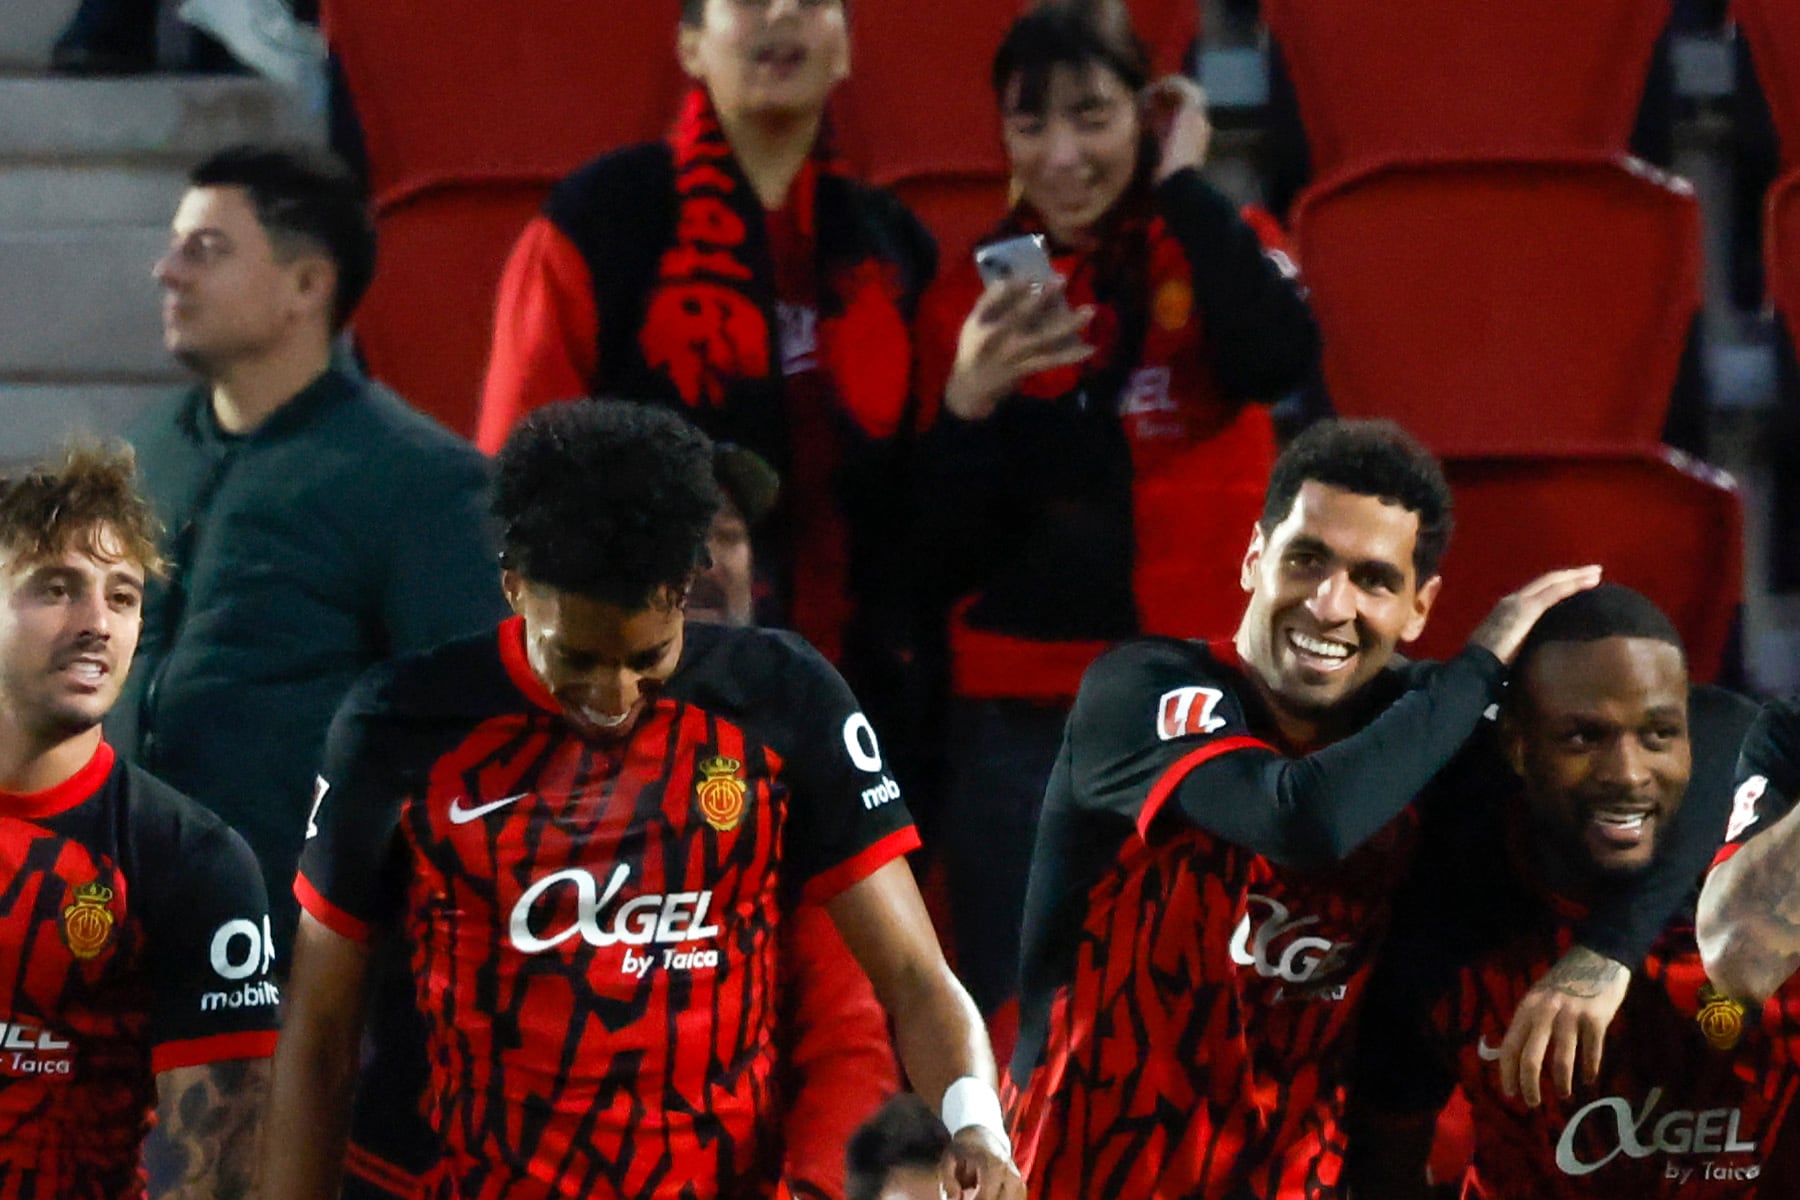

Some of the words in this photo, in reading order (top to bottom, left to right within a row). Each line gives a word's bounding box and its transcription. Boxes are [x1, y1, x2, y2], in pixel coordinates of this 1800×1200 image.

[621, 949, 654, 979] by
[663, 947, 718, 970] Taica
[12, 1052, 70, 1074] Taica
[1664, 1161, 1693, 1185] by
[1703, 1160, 1760, 1181] Taica
